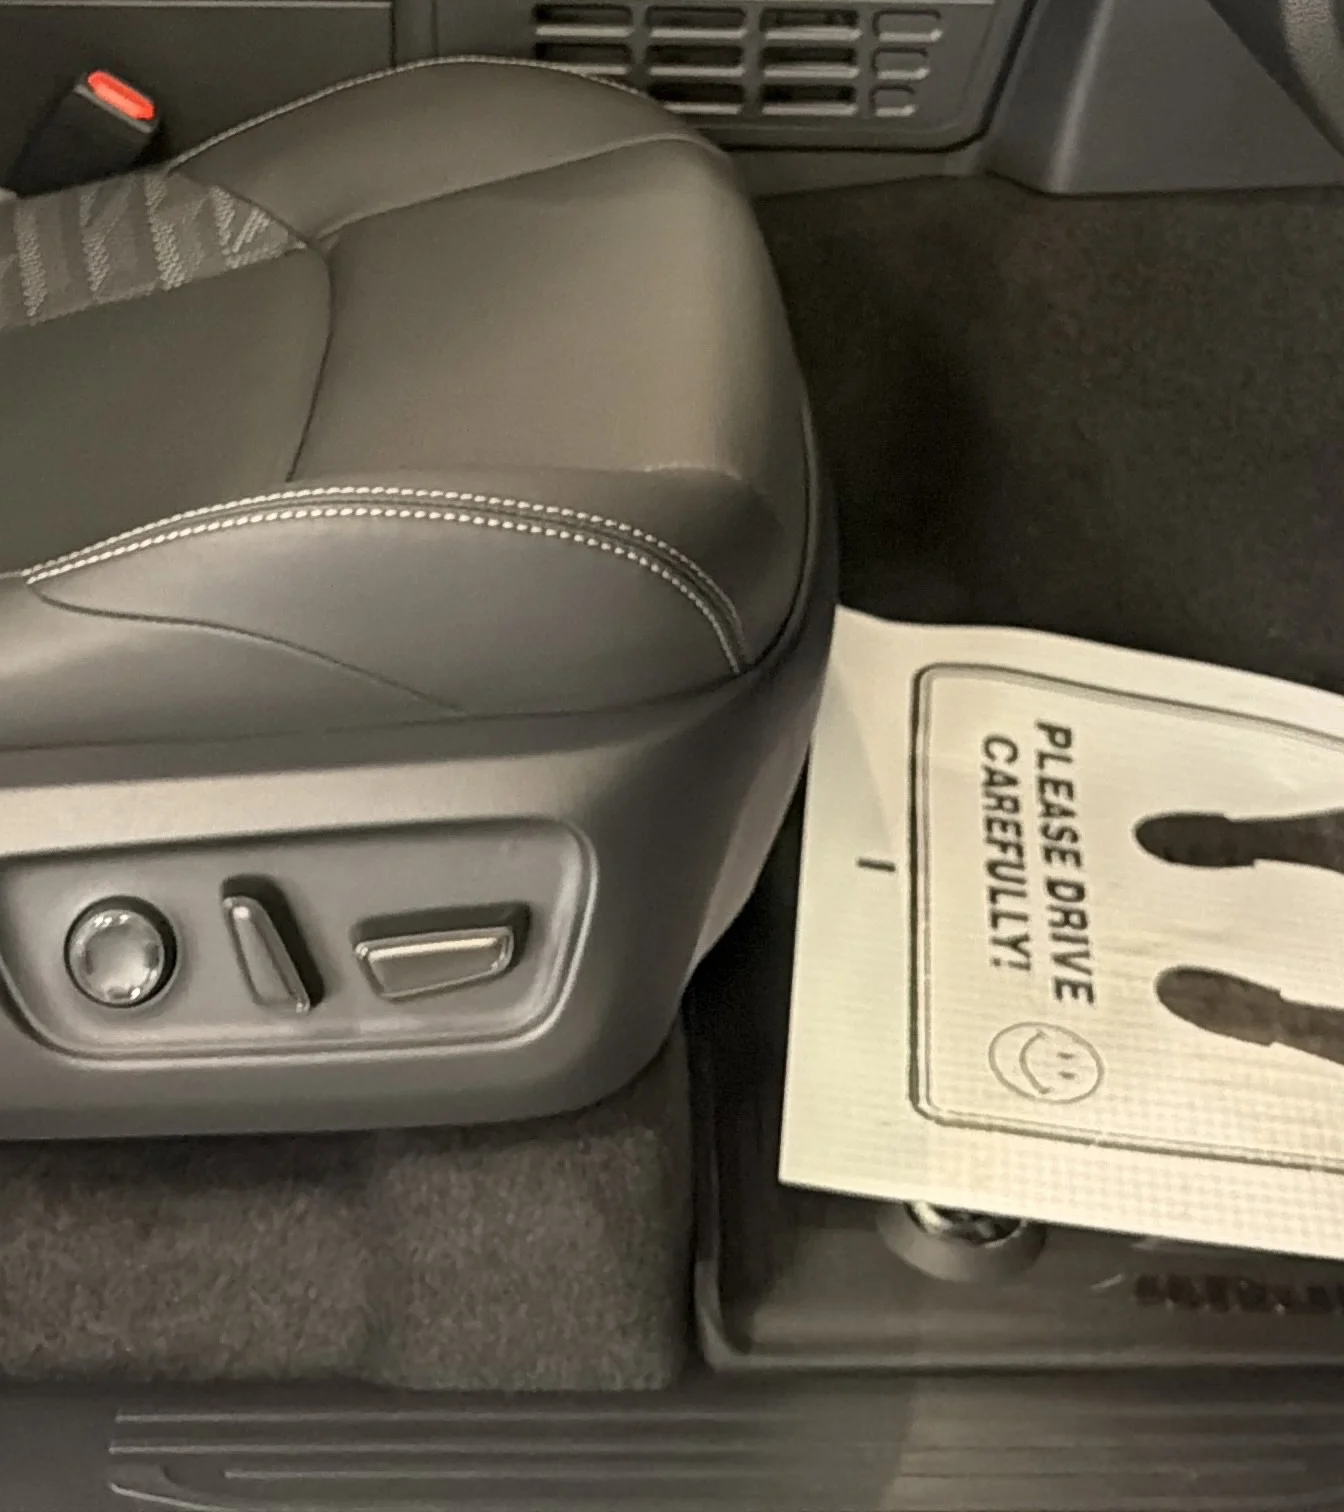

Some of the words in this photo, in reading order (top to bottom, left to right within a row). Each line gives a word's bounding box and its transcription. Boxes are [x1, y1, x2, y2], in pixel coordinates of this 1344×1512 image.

[981, 734, 1032, 972] CAREFULLY!
[1034, 718, 1083, 869] PLEASE
[1044, 875, 1096, 1005] DRIVE
